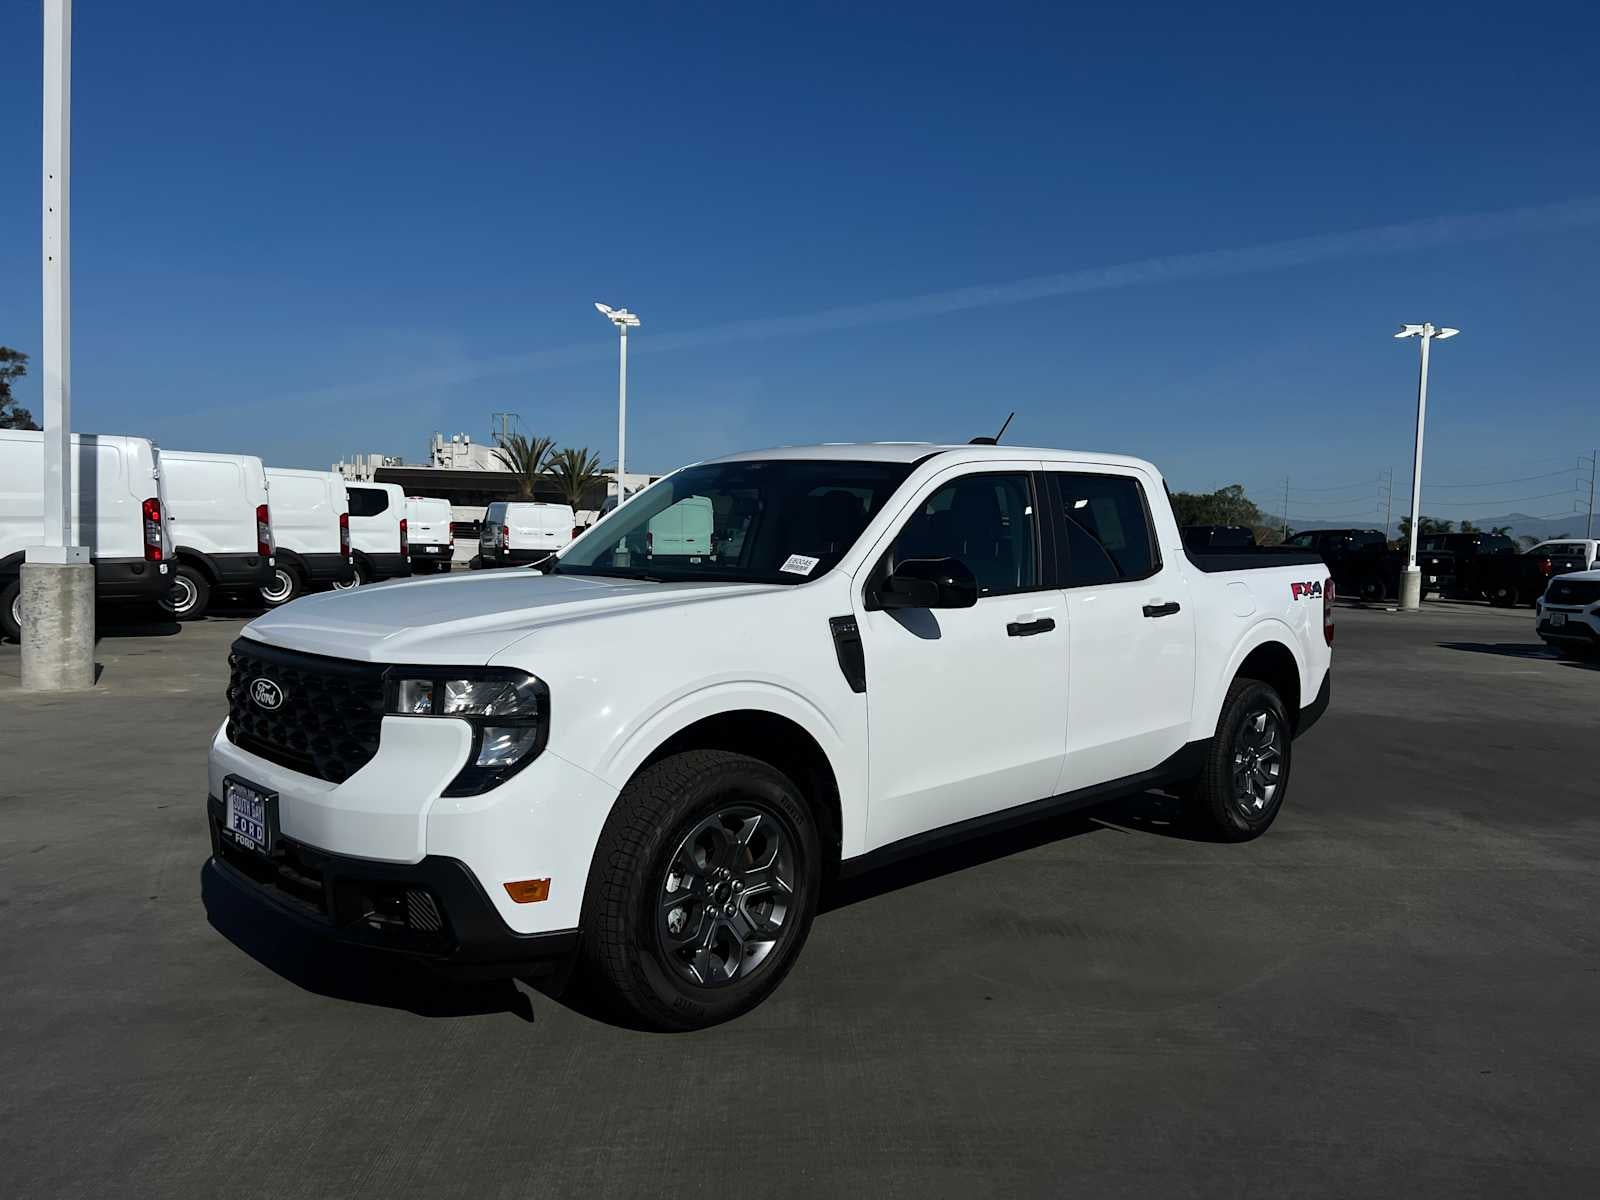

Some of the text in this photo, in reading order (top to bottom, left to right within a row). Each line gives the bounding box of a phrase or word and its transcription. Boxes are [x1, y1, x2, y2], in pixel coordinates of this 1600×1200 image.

[1291, 581, 1322, 600] FX4
[255, 681, 276, 705] Ford
[234, 815, 263, 841] FORD
[235, 832, 255, 850] FORD
